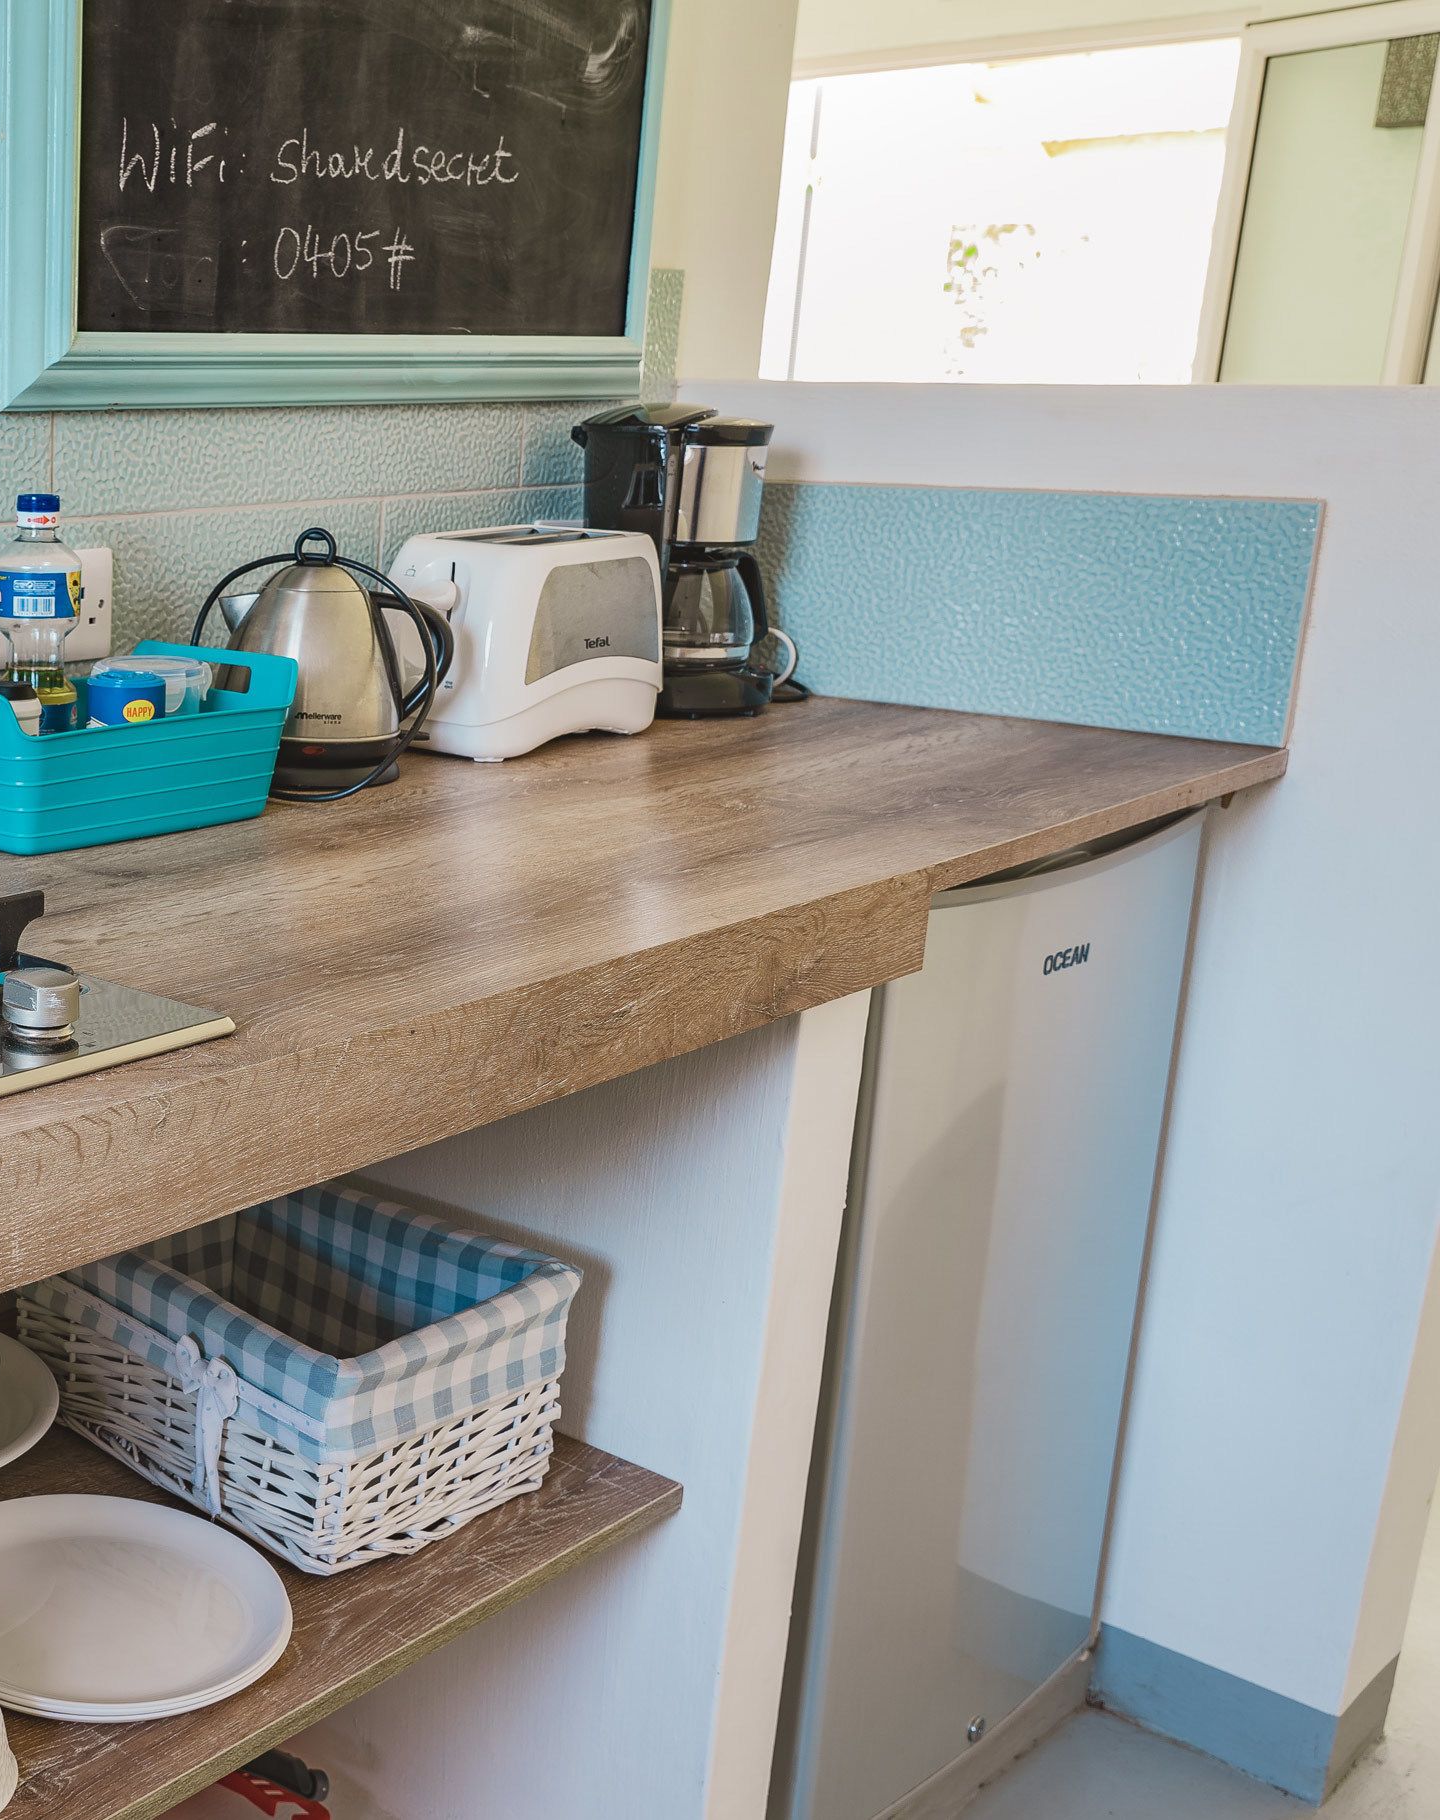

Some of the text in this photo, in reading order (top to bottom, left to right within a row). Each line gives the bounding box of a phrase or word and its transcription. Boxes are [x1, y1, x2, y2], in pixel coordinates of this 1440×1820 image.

[274, 225, 415, 290] 0405#
[583, 636, 610, 649] Tefal
[126, 706, 152, 718] HAPPY
[1042, 942, 1090, 976] OCEAN
